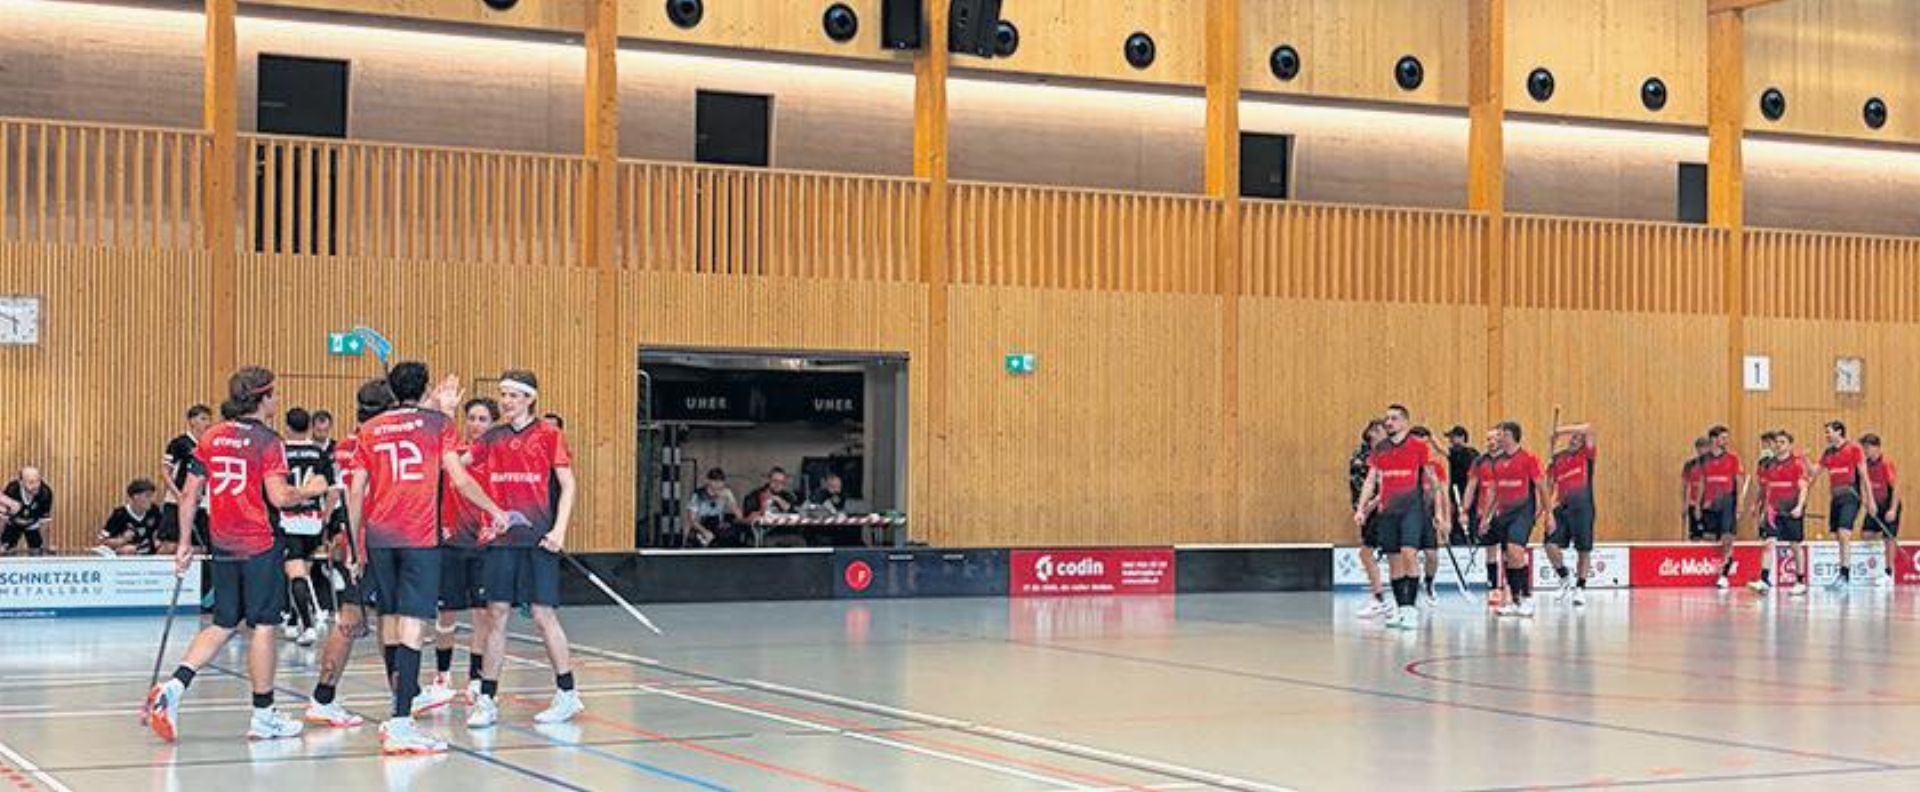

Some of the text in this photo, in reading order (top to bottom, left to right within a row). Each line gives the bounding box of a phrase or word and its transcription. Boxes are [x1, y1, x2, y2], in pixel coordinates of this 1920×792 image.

[1754, 361, 1761, 384] 1
[373, 440, 424, 483] 72
[1056, 557, 1105, 576] codin
[0, 570, 101, 585] SCHNETZLER
